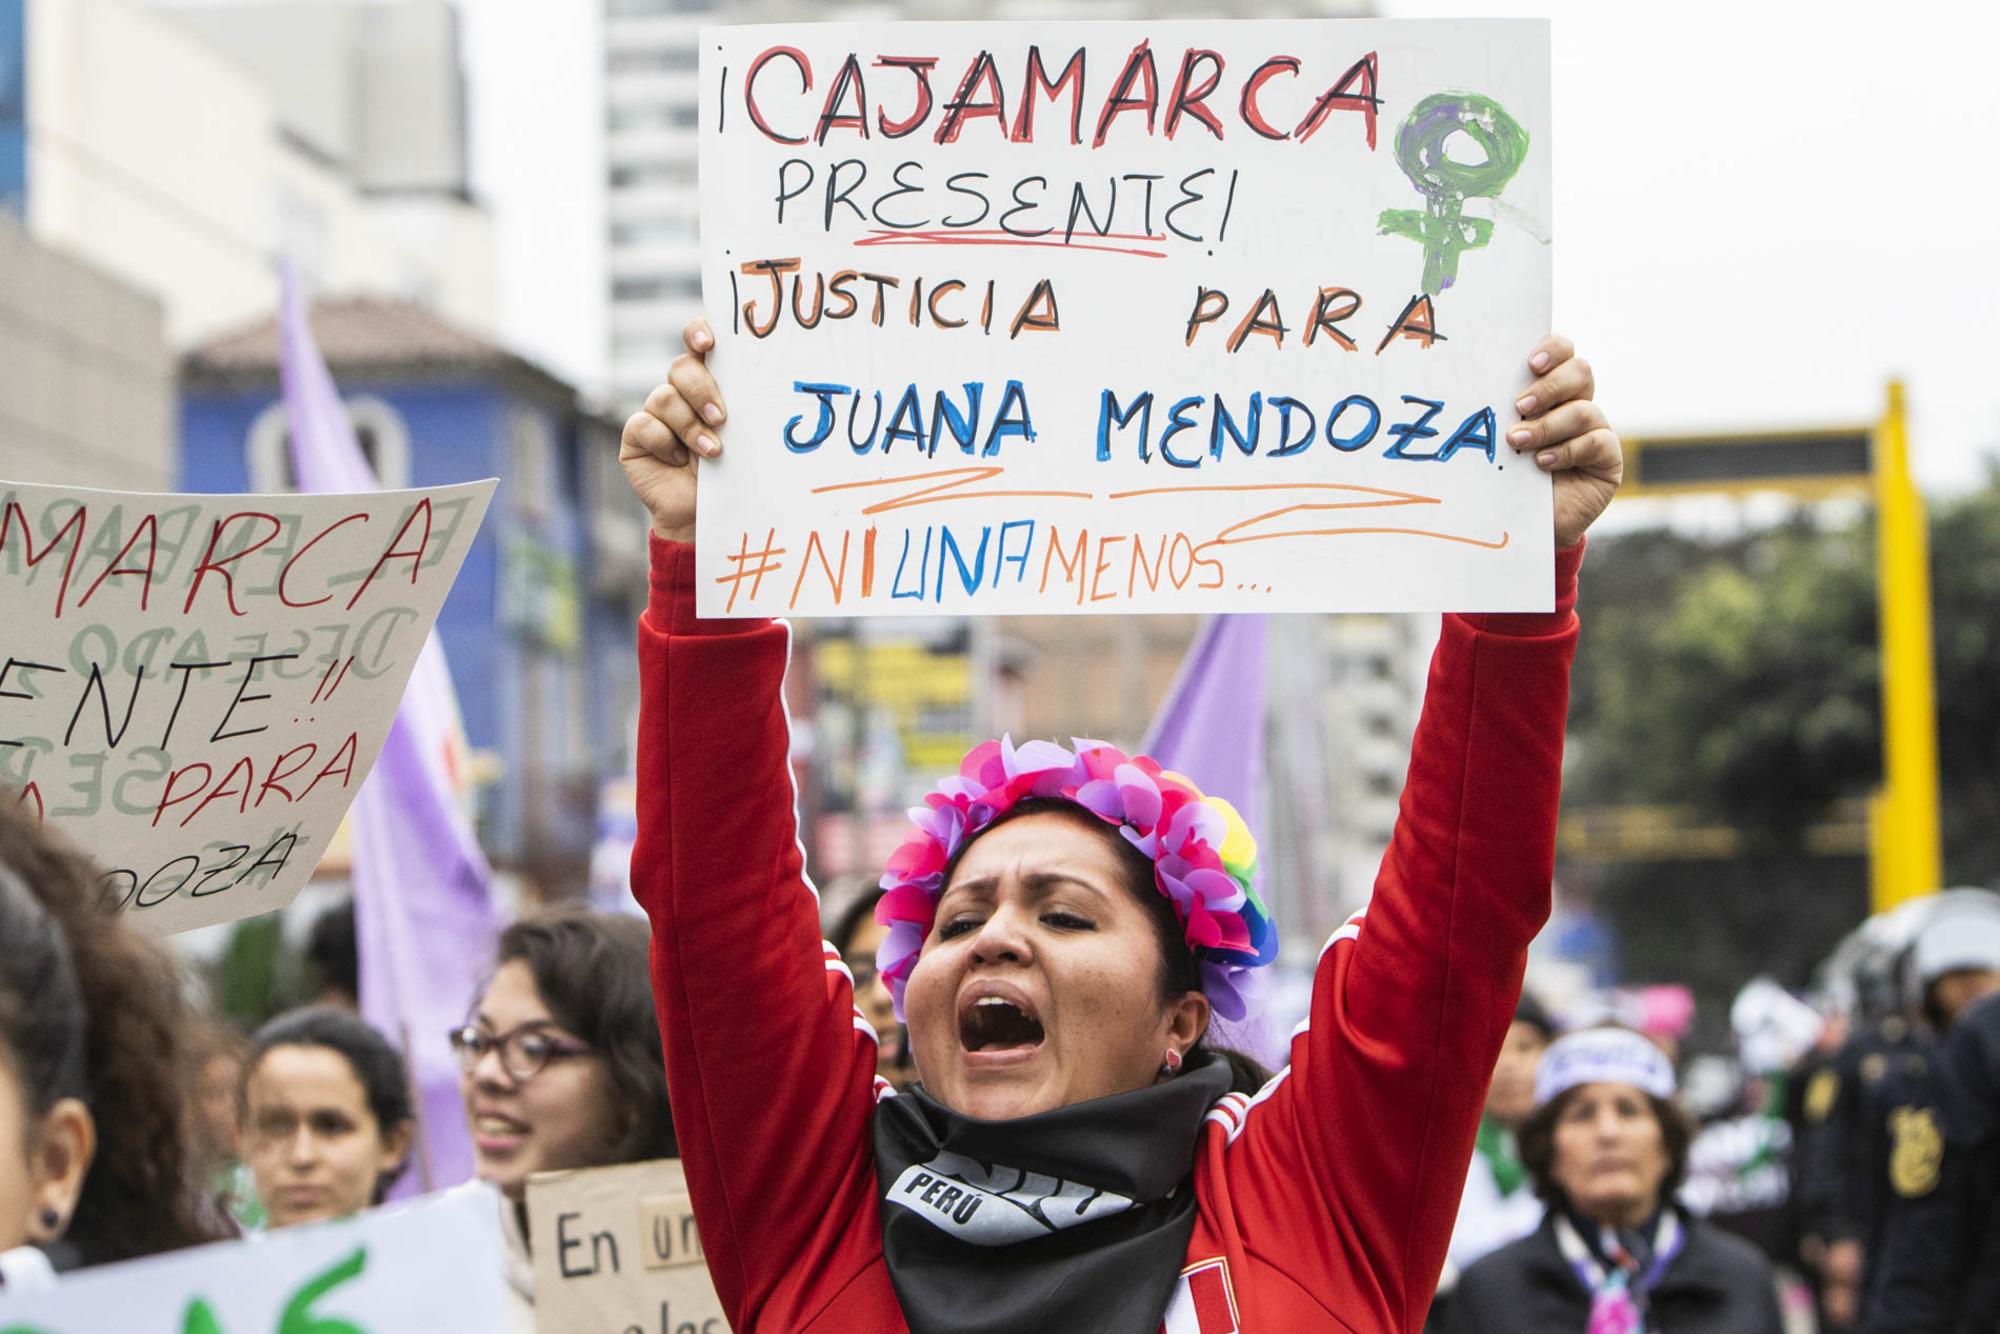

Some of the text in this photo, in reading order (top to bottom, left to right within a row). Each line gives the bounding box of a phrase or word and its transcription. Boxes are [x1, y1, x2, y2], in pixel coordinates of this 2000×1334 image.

[775, 158, 1239, 257] PRESENTE!
[1185, 285, 1449, 356] PARA
[783, 379, 1038, 459] JUANA
[151, 731, 358, 828] PARA
[903, 1172, 985, 1226] PERÚ
[557, 1211, 620, 1280] En
